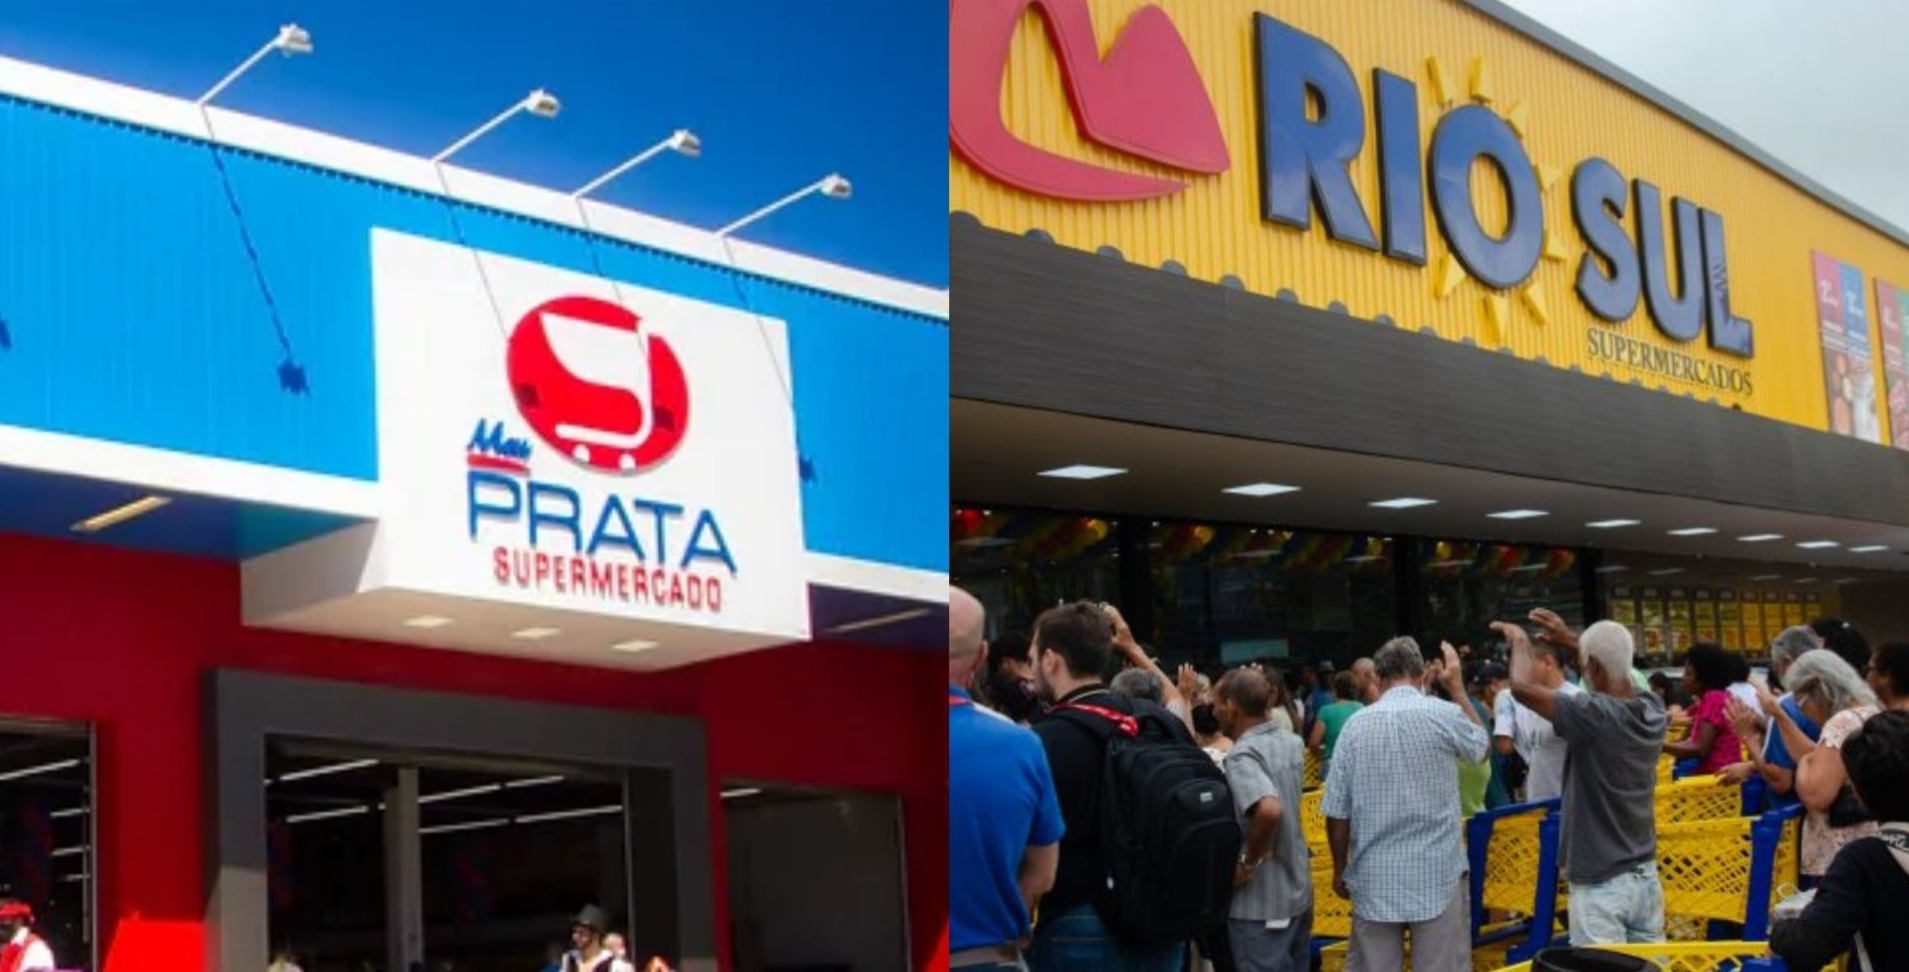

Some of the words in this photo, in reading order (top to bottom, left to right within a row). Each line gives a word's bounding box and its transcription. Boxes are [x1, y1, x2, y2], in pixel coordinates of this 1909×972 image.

[1253, 12, 1544, 290] RIO
[1570, 157, 1754, 358] SUL
[1587, 328, 1754, 396] SUPERMERCADOS
[467, 470, 737, 575] PRATA
[493, 546, 722, 611] SUPERMERCADO
